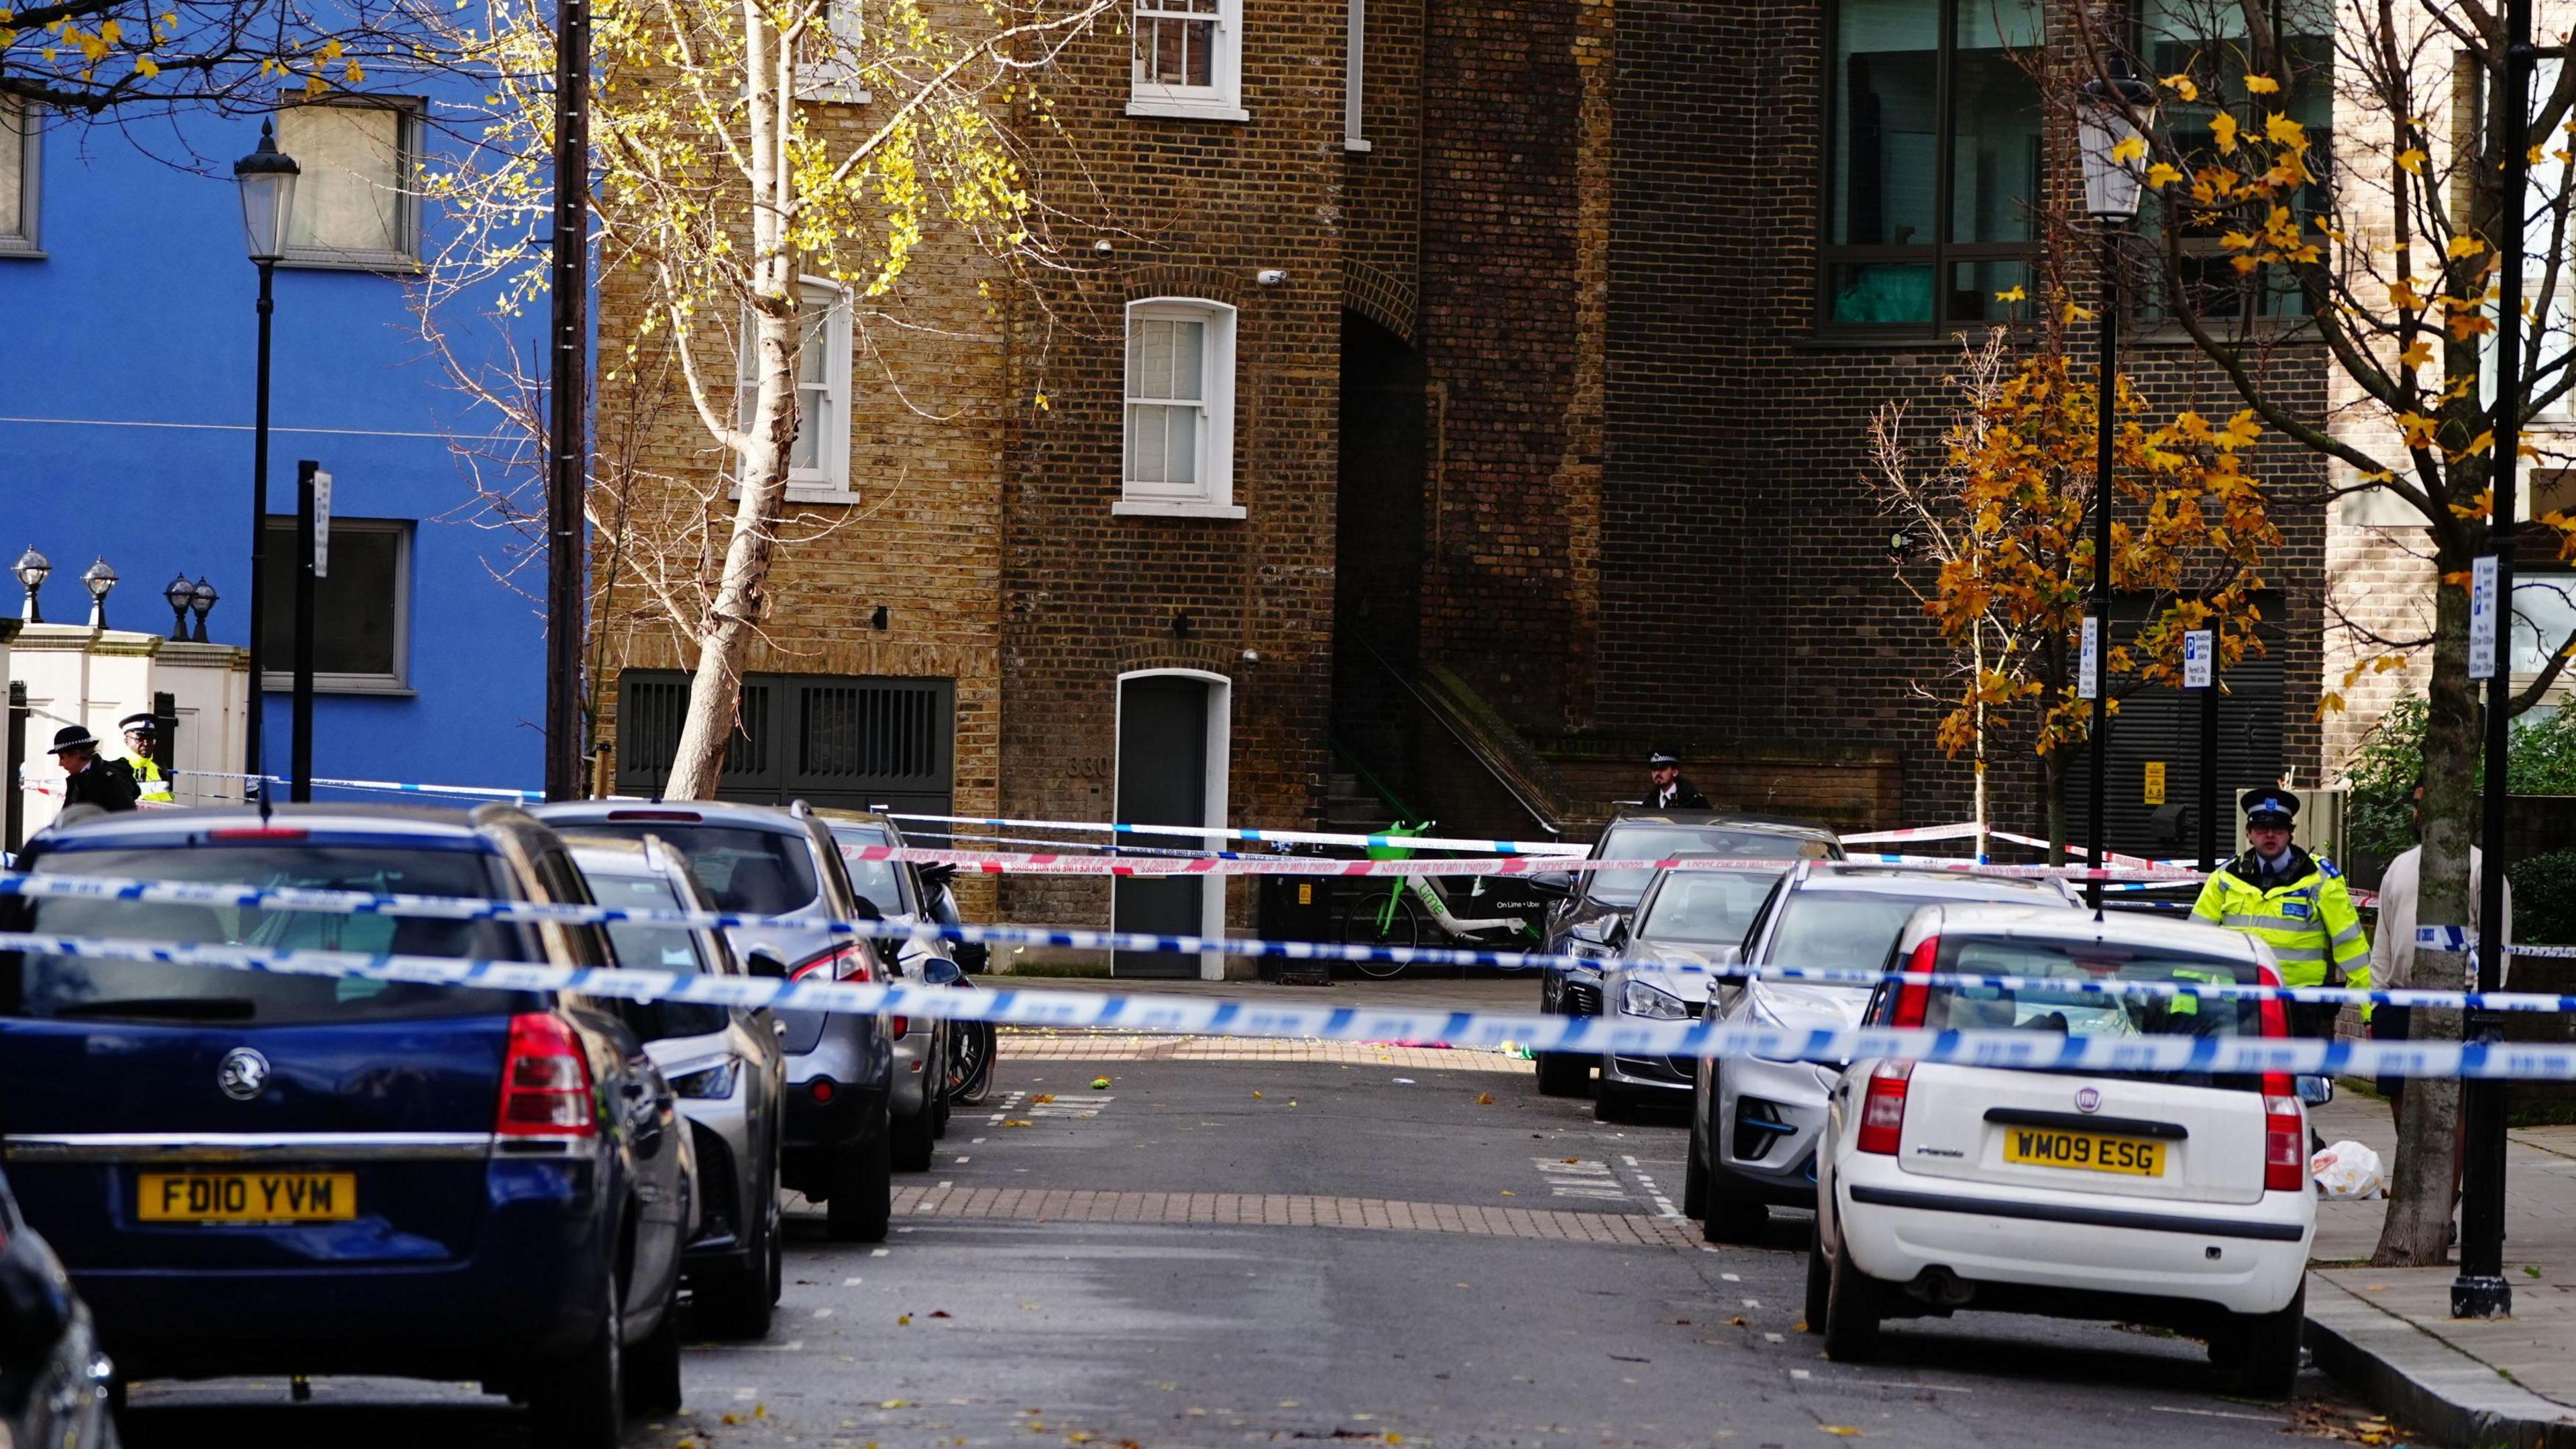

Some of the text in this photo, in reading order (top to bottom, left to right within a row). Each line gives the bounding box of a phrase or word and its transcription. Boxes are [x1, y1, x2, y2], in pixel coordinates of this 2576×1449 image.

[1067, 756, 1109, 777] 330
[2018, 1132, 2153, 1169] WM09 ESG
[163, 1178, 332, 1213] FD10 YVM
